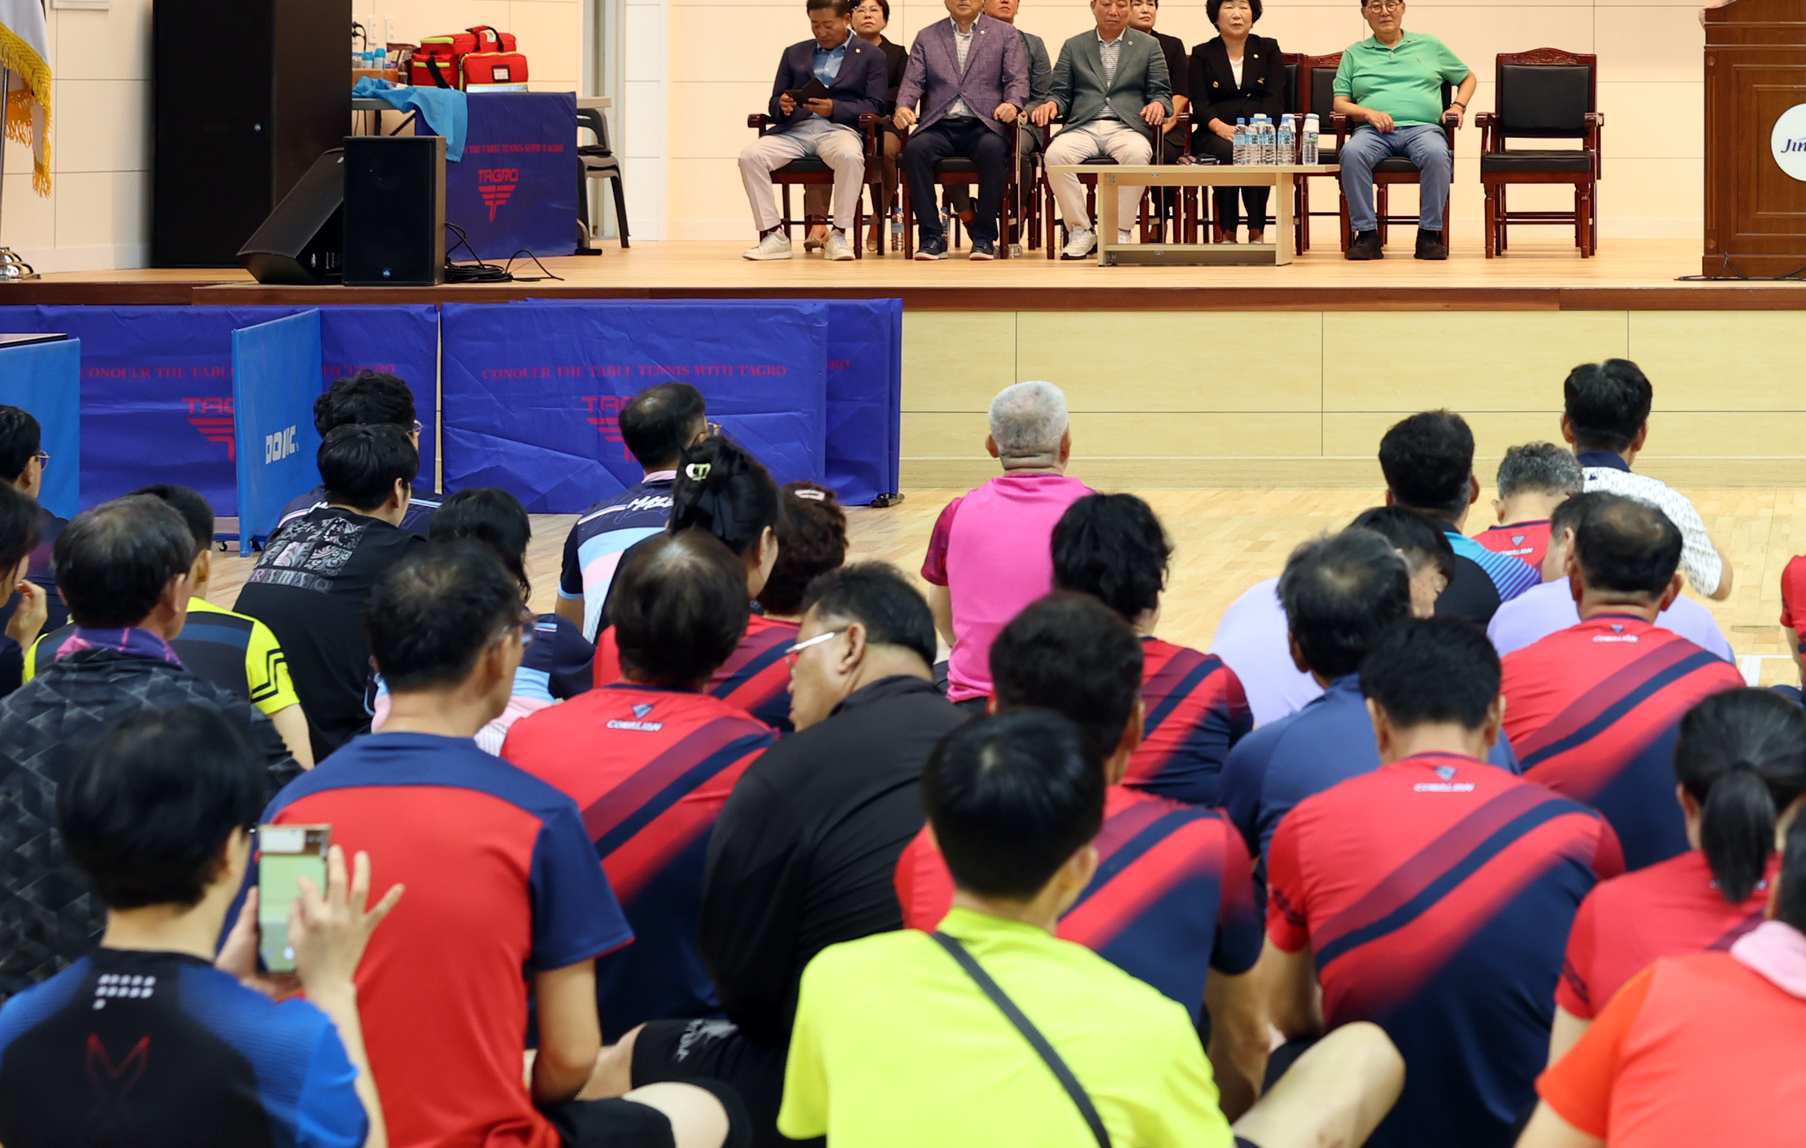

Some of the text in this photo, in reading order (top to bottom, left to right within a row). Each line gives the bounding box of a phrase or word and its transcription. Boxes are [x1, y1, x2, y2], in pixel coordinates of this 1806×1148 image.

[478, 168, 520, 183] TAGRO
[155, 367, 186, 379] THE
[482, 365, 788, 380] CONQUER THE TABLE TENNIS WITH TAGRO
